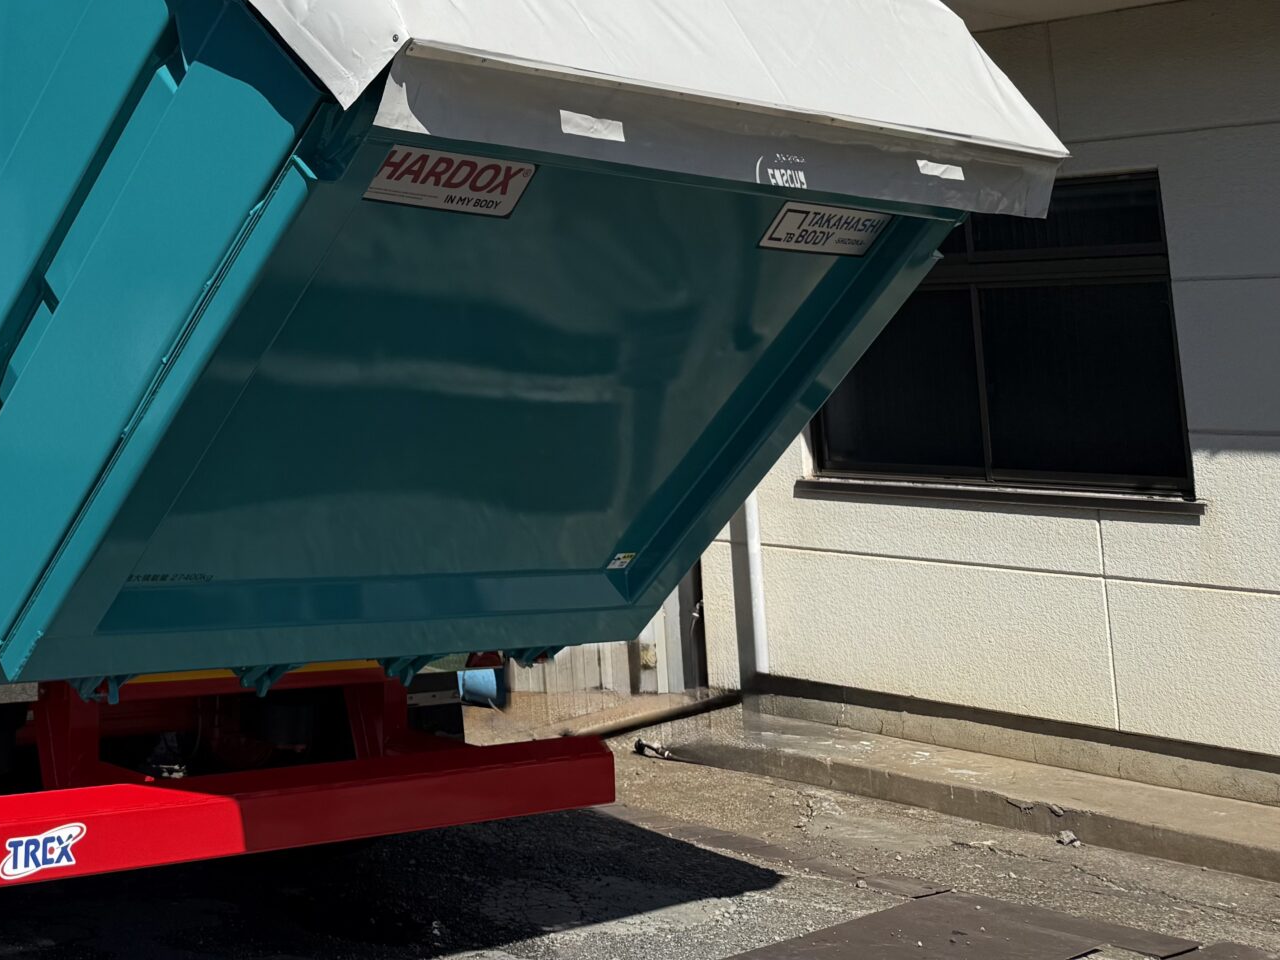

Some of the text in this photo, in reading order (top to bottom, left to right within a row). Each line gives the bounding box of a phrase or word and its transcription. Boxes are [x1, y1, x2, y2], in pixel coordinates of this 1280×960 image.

[444, 194, 502, 210] IN MY BODY
[808, 212, 884, 234] TAKAHASHI
[782, 232, 794, 242] TB
[794, 229, 835, 246] BODY
[8, 834, 73, 869] TREX
